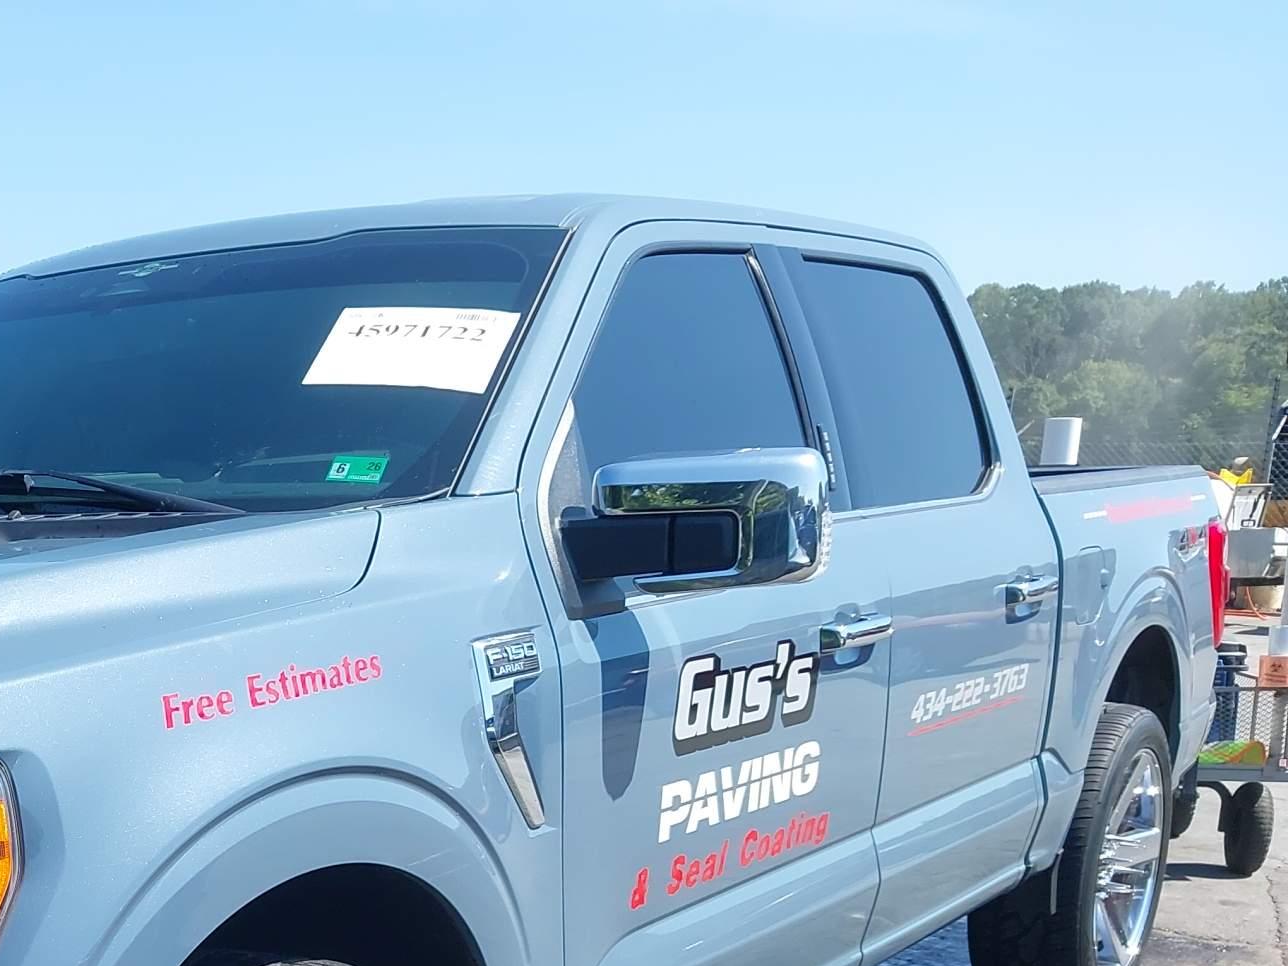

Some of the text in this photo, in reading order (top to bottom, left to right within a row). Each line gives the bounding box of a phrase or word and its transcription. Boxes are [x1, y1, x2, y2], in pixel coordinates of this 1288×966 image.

[348, 324, 486, 342] 45971722
[367, 461, 382, 471] 26
[486, 642, 537, 665] F-150
[493, 661, 525, 676] LARIAT
[161, 653, 383, 729] Free Estimates
[673, 639, 817, 755] Gus's
[910, 663, 1030, 724] 434-222-3763
[658, 741, 821, 843] PAVING
[629, 811, 831, 911] & Seal Coating
